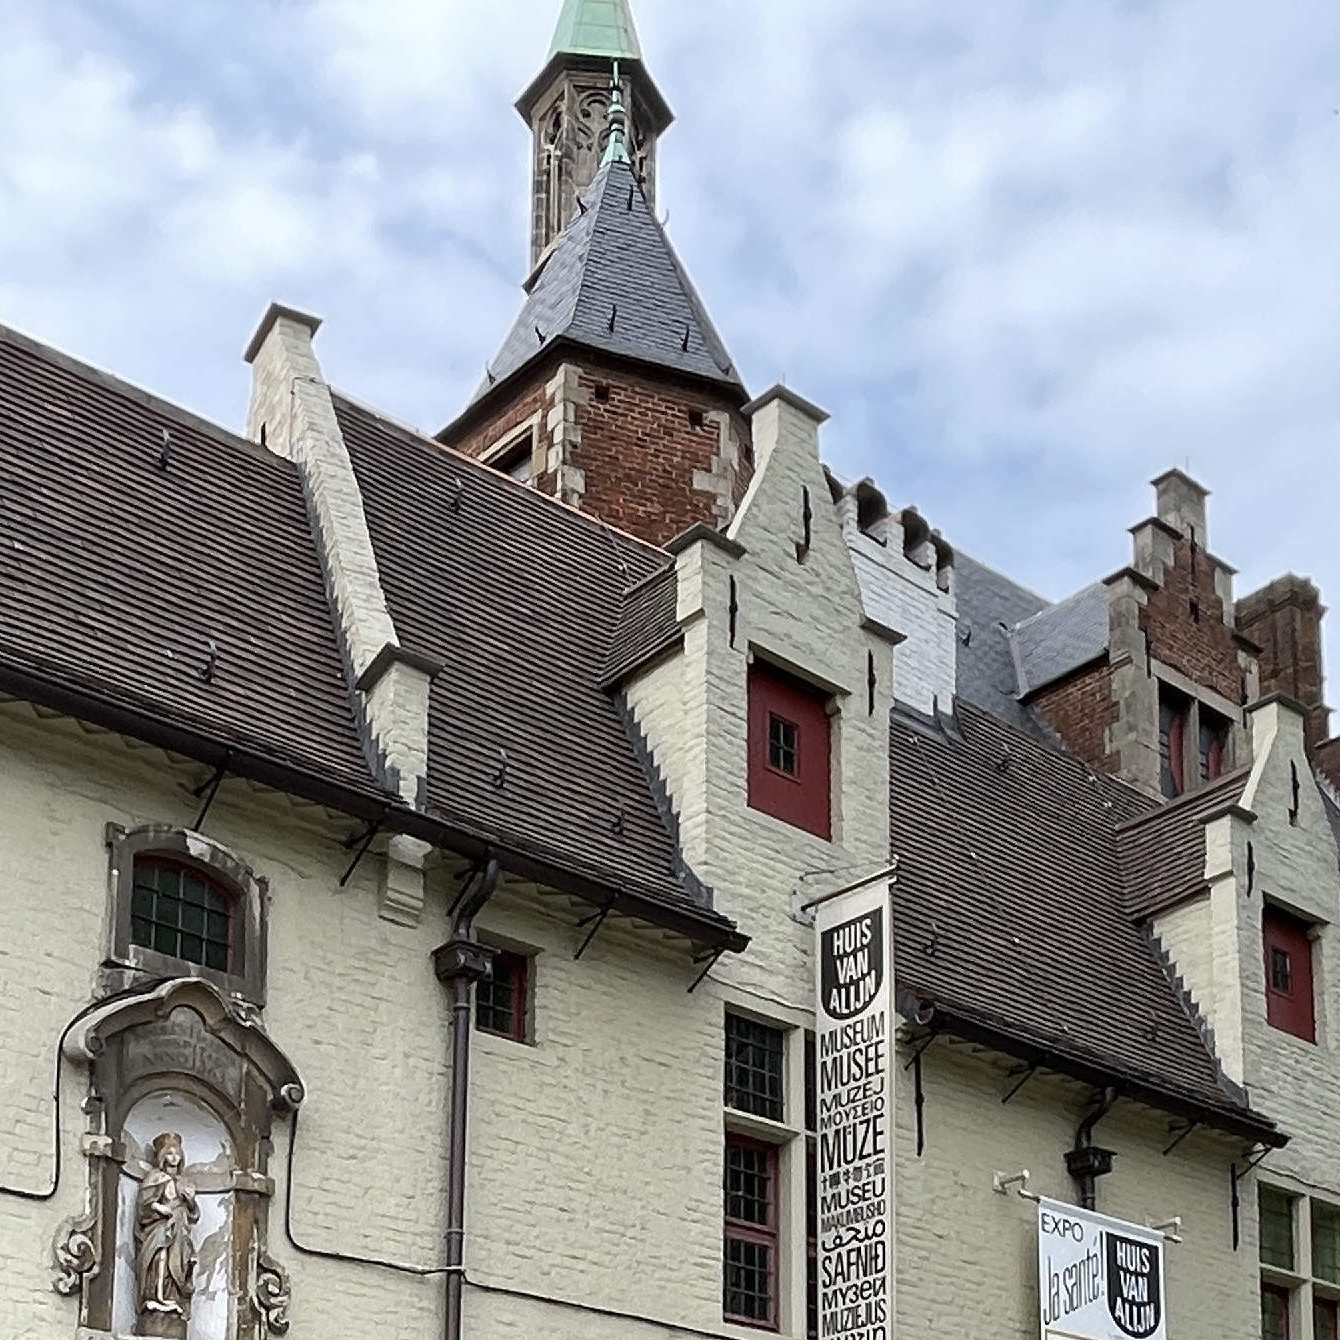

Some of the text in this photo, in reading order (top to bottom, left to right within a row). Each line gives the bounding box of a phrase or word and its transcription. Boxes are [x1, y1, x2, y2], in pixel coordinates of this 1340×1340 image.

[832, 918, 872, 956] HUIS
[836, 948, 869, 985] VAN
[829, 969, 876, 1014] ALIJN
[820, 1011, 885, 1059] MUSEUM
[820, 1076, 885, 1115] MUZEJ
[820, 1112, 885, 1174] MÜZE
[820, 1177, 886, 1215] MUSEU
[1041, 1212, 1084, 1243] EXPO
[1116, 1240, 1151, 1274] HUIS
[1119, 1270, 1149, 1302] VAN
[822, 1297, 887, 1338] MUZIEJUS
[1114, 1296, 1156, 1333] ALIJN
